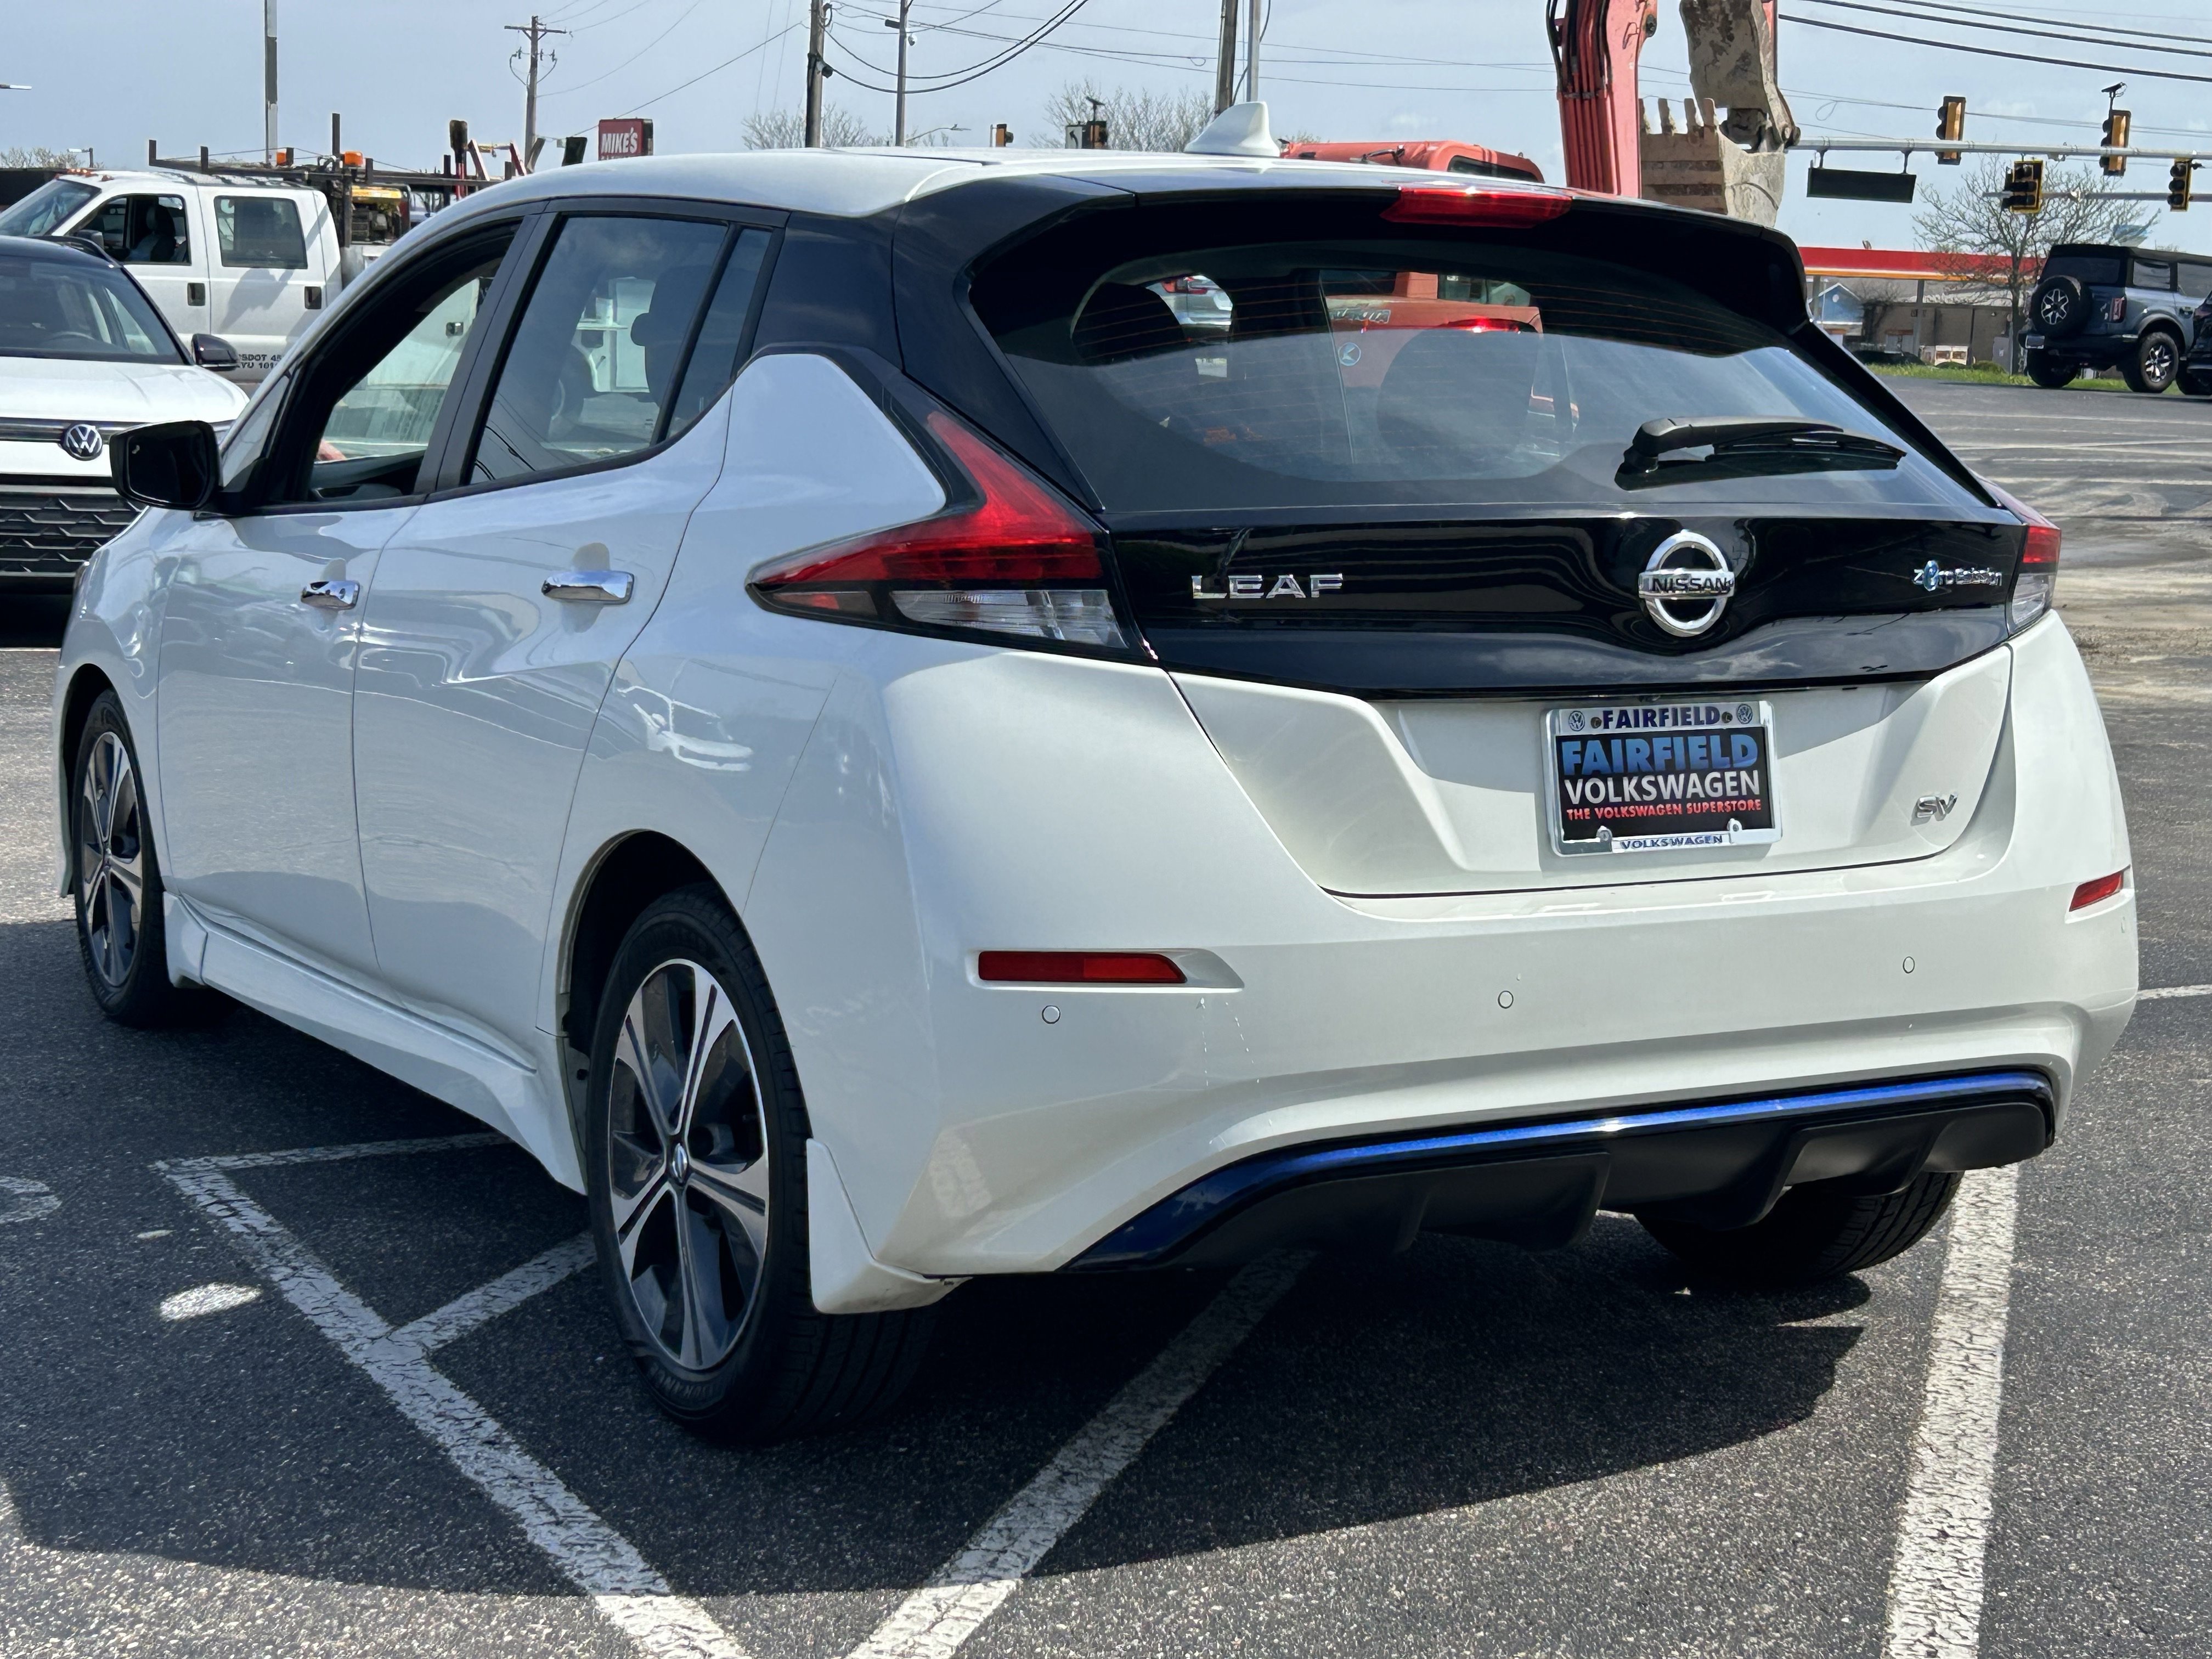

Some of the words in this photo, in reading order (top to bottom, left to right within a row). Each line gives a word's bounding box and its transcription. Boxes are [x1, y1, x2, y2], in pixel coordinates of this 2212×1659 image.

[601, 127, 638, 154] MIKE'S
[1191, 573, 1343, 599] LEAF
[1652, 577, 1727, 593] NISSAN
[1602, 706, 1721, 730] FAIRFIELD
[1561, 734, 1758, 776] FAIRFIELD
[1564, 770, 1760, 805] VOLKSWAGEN
[1566, 808, 1591, 821] THE
[1594, 803, 1683, 820] VOLKSWAGEN
[1686, 799, 1762, 814] SUPERSTORE
[1916, 793, 1958, 818] SV
[1621, 835, 1723, 849] VOLKSWAGEN
